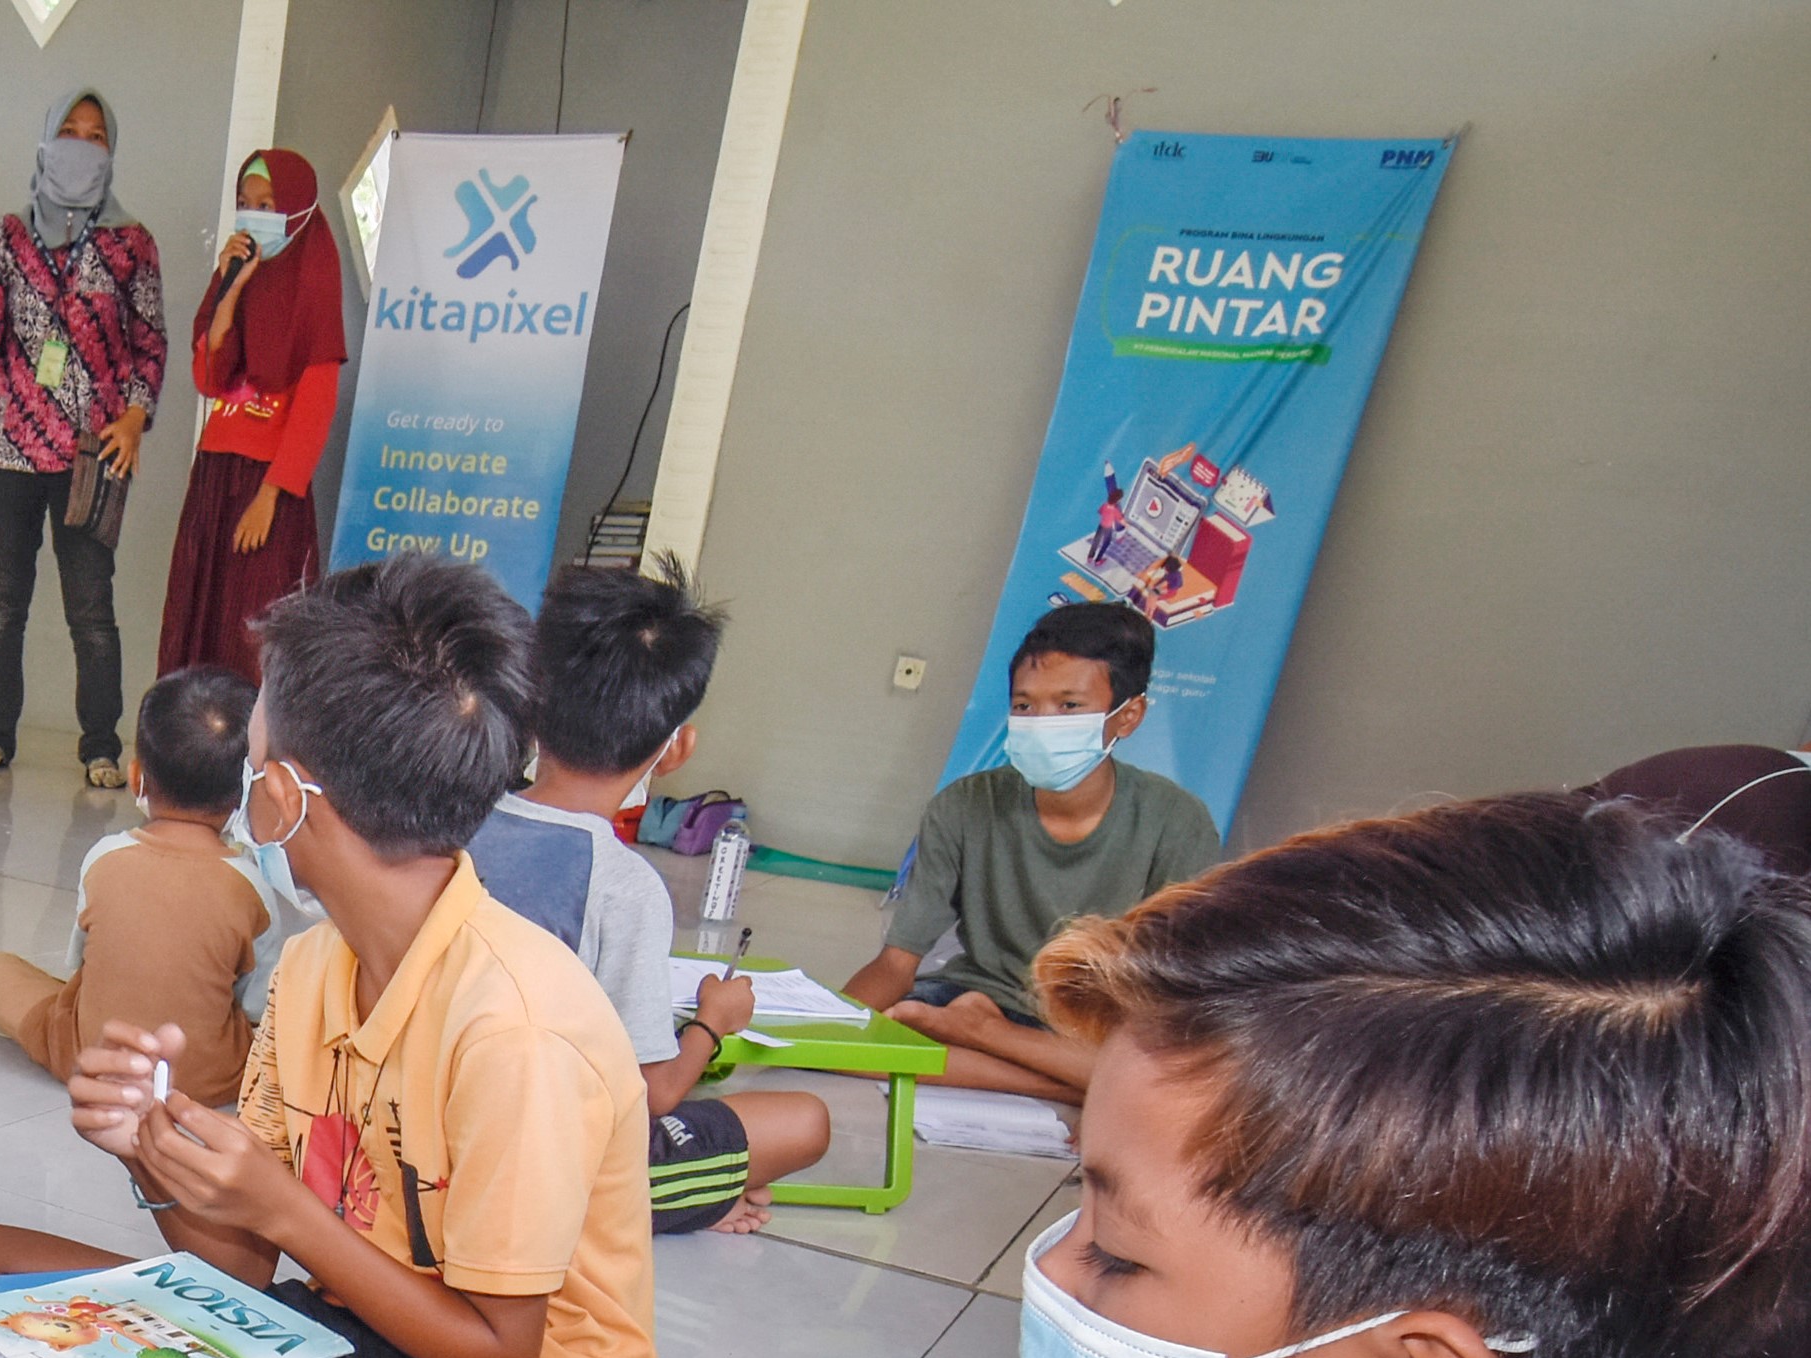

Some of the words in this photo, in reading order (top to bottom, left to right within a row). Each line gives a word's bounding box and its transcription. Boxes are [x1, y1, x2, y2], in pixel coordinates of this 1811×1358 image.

[1381, 150, 1435, 166] PNM
[1180, 229, 1229, 239] PROGRAM
[1231, 231, 1254, 240] BINA
[1257, 232, 1325, 242] LINGKUNGAN
[1148, 245, 1346, 291] RUANG
[374, 287, 588, 343] kitapixel
[1136, 292, 1328, 337] PINTAR
[1200, 350, 1240, 359] NASIONAL
[387, 411, 418, 429] Get
[424, 413, 480, 436] ready
[484, 416, 504, 433] to
[380, 445, 508, 475] Innovate
[373, 486, 540, 520] Collaborate
[367, 527, 440, 554] Grow
[449, 533, 487, 562] Up
[134, 1261, 309, 1357] VISION
